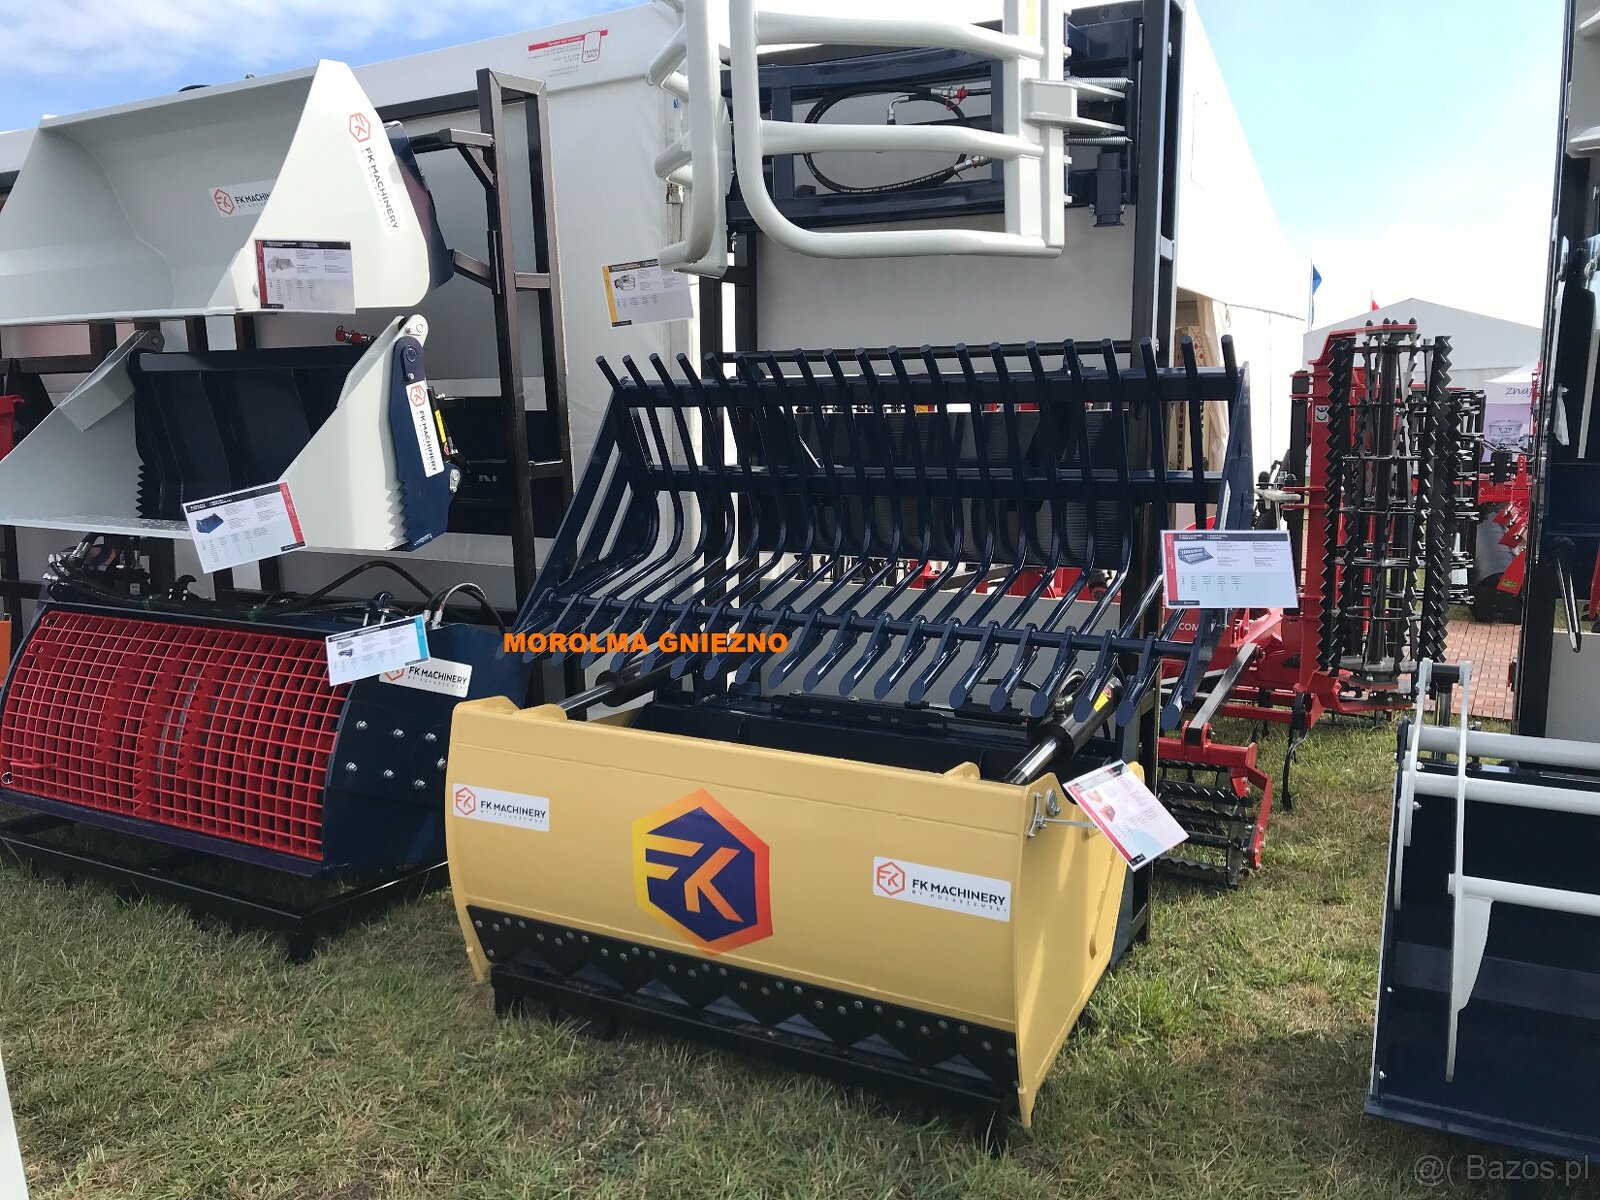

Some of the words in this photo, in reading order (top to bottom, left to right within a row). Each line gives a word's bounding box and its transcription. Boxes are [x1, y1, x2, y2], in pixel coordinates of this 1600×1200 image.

[365, 147, 375, 163] FK
[371, 164, 399, 229] MACHINERY
[235, 196, 246, 204] FK
[419, 410, 426, 421] FK
[422, 423, 437, 471] MACHINERY
[408, 666, 420, 675] FK
[421, 669, 467, 684] MACHINERY
[481, 800, 492, 810] FK
[493, 803, 546, 819] MACHINERY
[912, 879, 928, 891] FK
[931, 883, 1006, 905] MACHINERY
